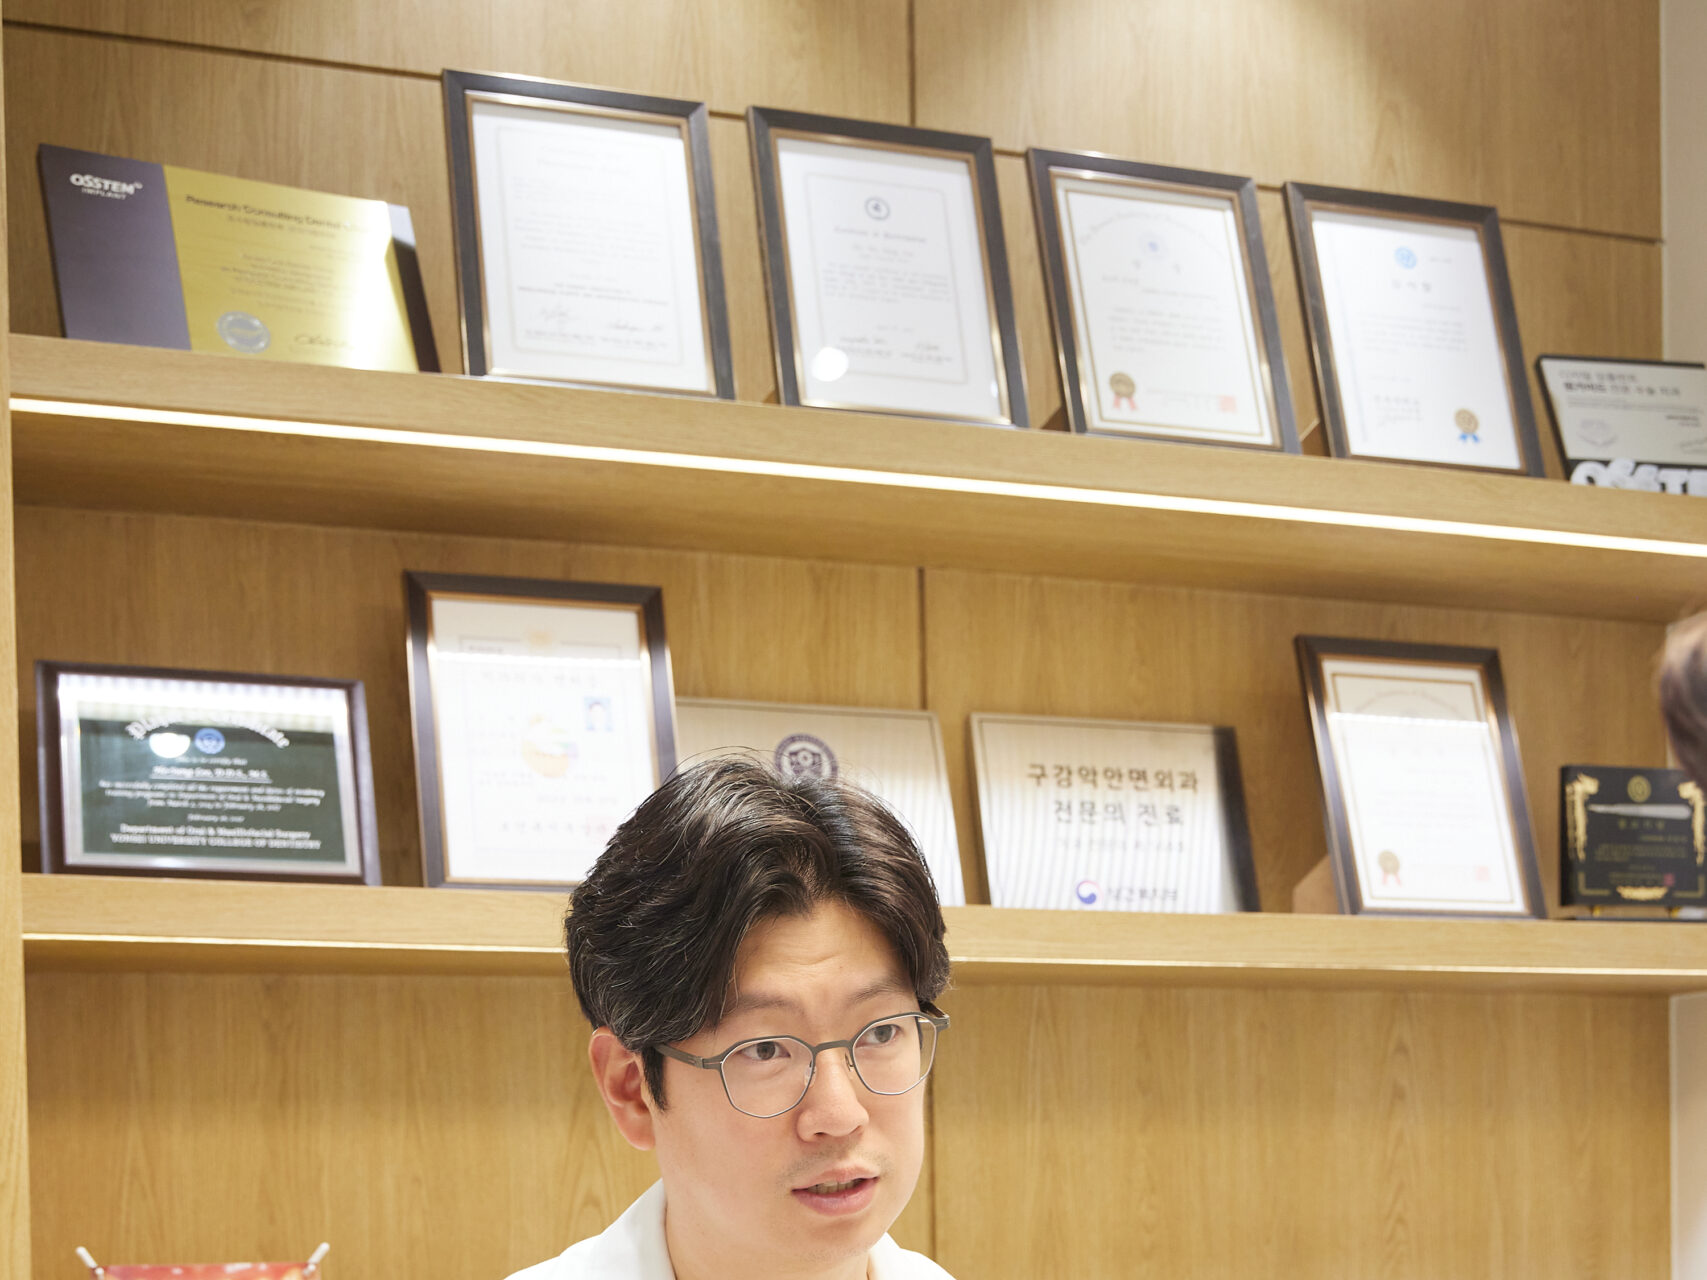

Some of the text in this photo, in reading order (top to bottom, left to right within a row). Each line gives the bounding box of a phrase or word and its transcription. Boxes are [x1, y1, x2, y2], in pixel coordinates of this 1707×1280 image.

[69, 173, 136, 195] OSSTEM
[1027, 763, 1198, 794] 구강악안면외과
[1054, 800, 1185, 827] 전문의 진료
